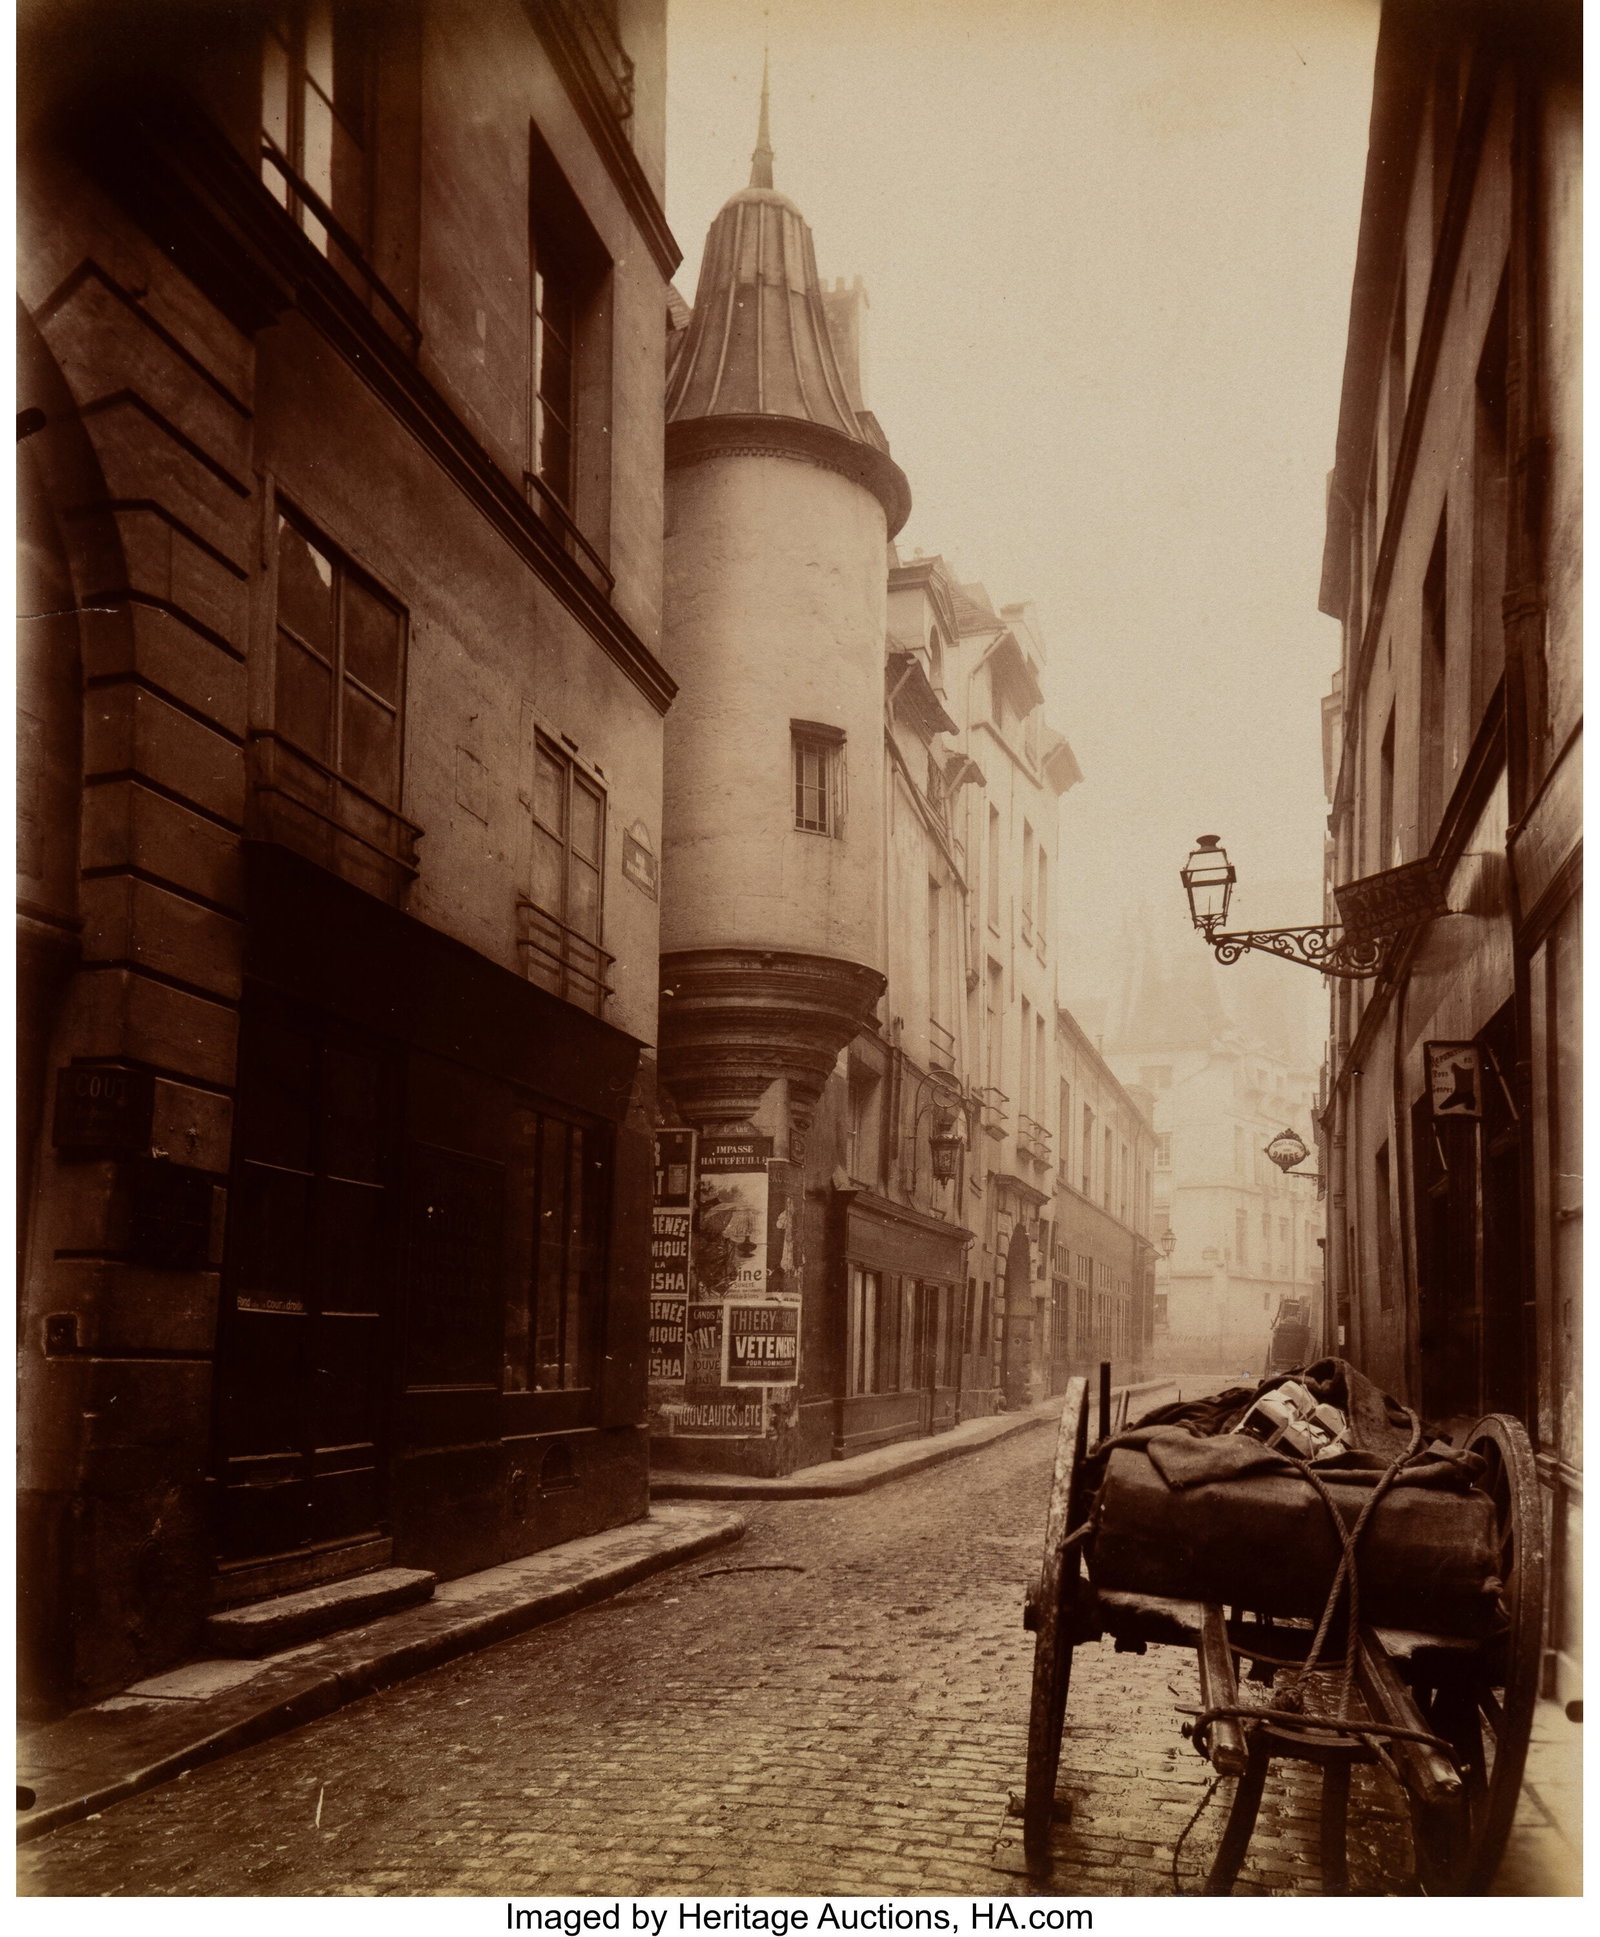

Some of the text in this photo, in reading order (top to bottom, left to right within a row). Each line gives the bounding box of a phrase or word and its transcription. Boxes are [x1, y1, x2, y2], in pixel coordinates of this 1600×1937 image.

[716, 1145, 754, 1154] IMPASSE
[1271, 1151, 1299, 1161] DANSE
[651, 1346, 662, 1354] LA
[746, 1359, 762, 1368] POUR
